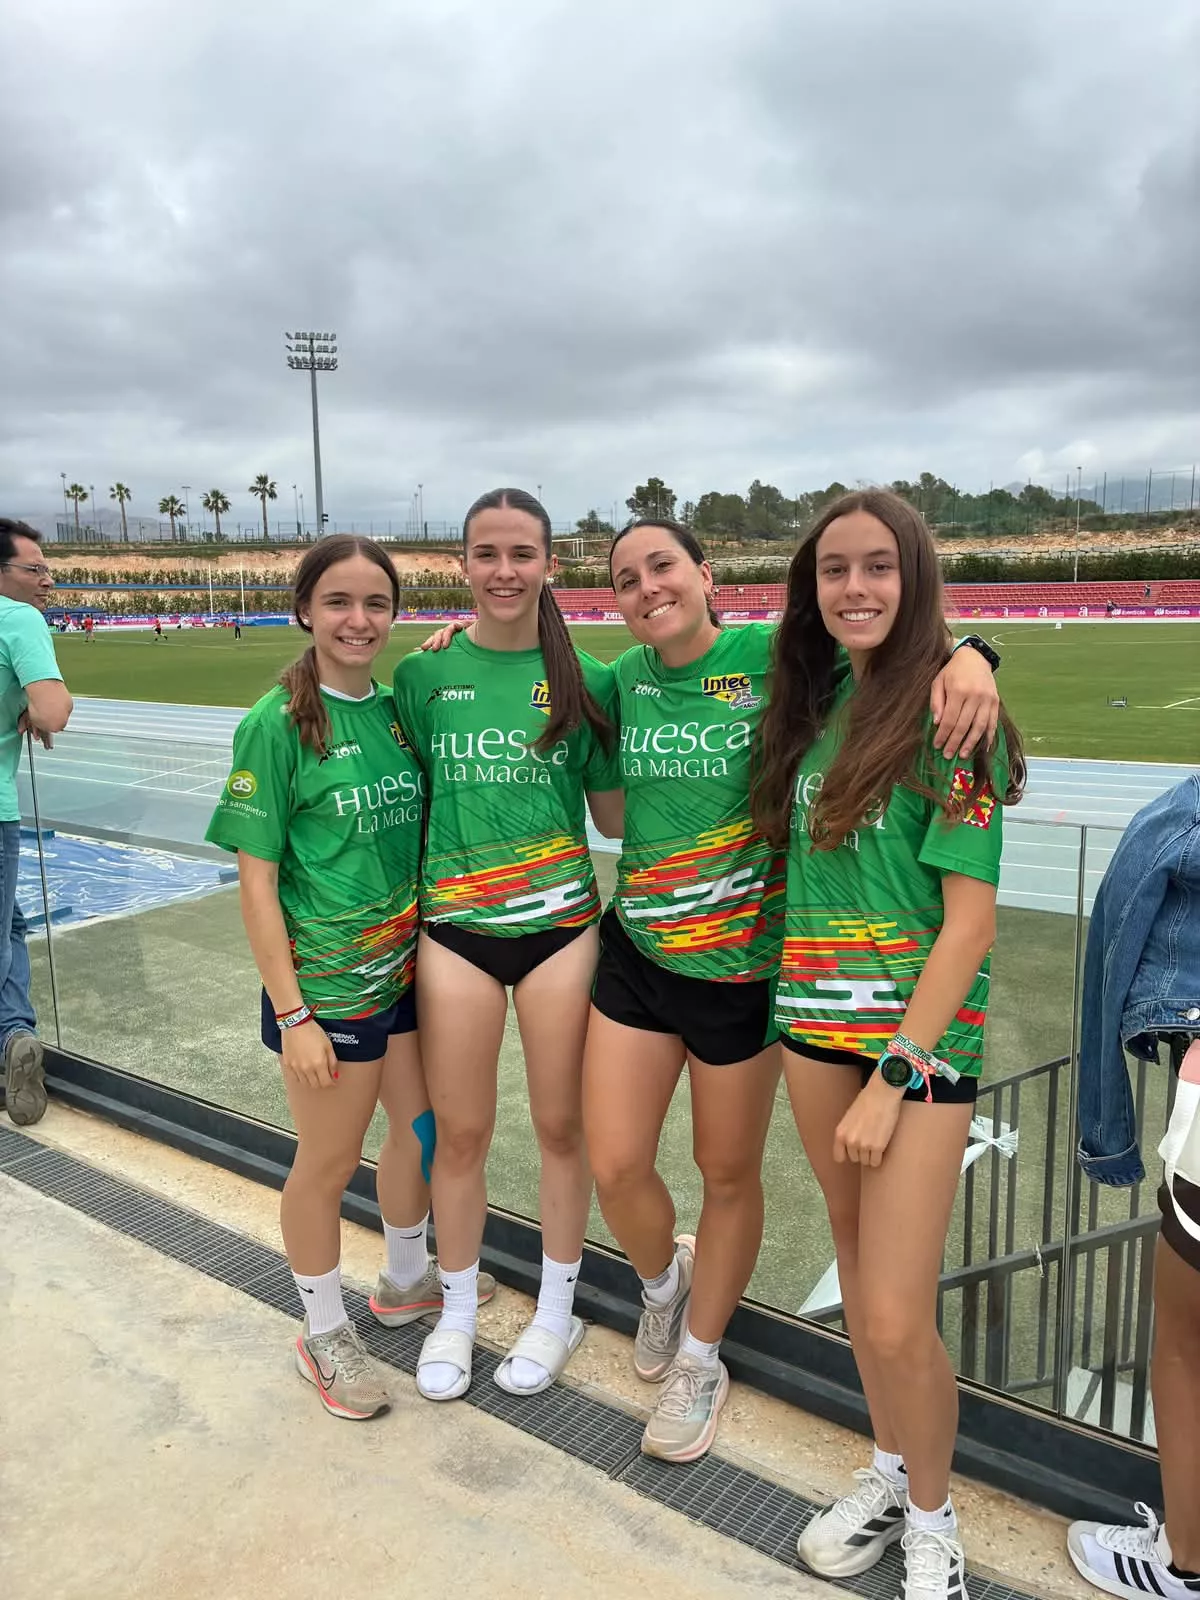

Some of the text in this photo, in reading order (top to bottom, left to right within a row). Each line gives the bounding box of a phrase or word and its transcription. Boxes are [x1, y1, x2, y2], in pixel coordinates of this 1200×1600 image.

[442, 689, 475, 701] ZOITI
[703, 675, 751, 691] Intec
[431, 728, 569, 765] Huesca
[620, 721, 751, 754] Huesca
